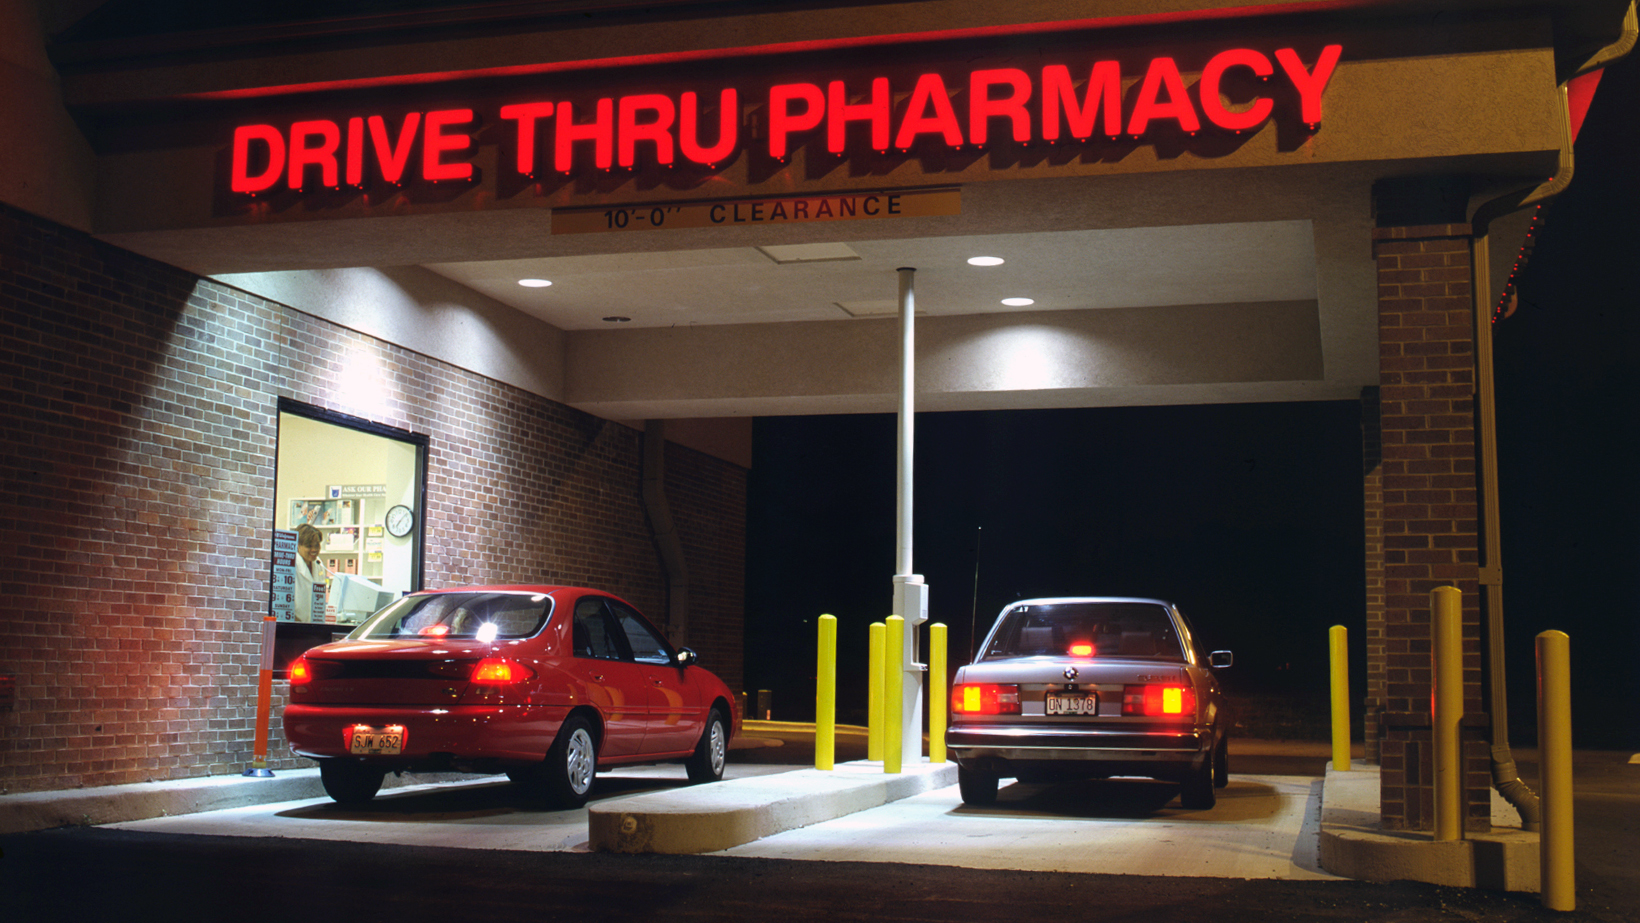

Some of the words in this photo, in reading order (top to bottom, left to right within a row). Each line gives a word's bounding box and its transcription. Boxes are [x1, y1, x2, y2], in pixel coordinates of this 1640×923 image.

[231, 109, 474, 193] DRIVE
[500, 88, 738, 174] THRU
[769, 44, 1343, 159] PHARMACY
[709, 195, 902, 224] CLEARANCE
[1066, 698, 1093, 711] 1378
[355, 735, 374, 748] SJW
[379, 735, 399, 748] 652
